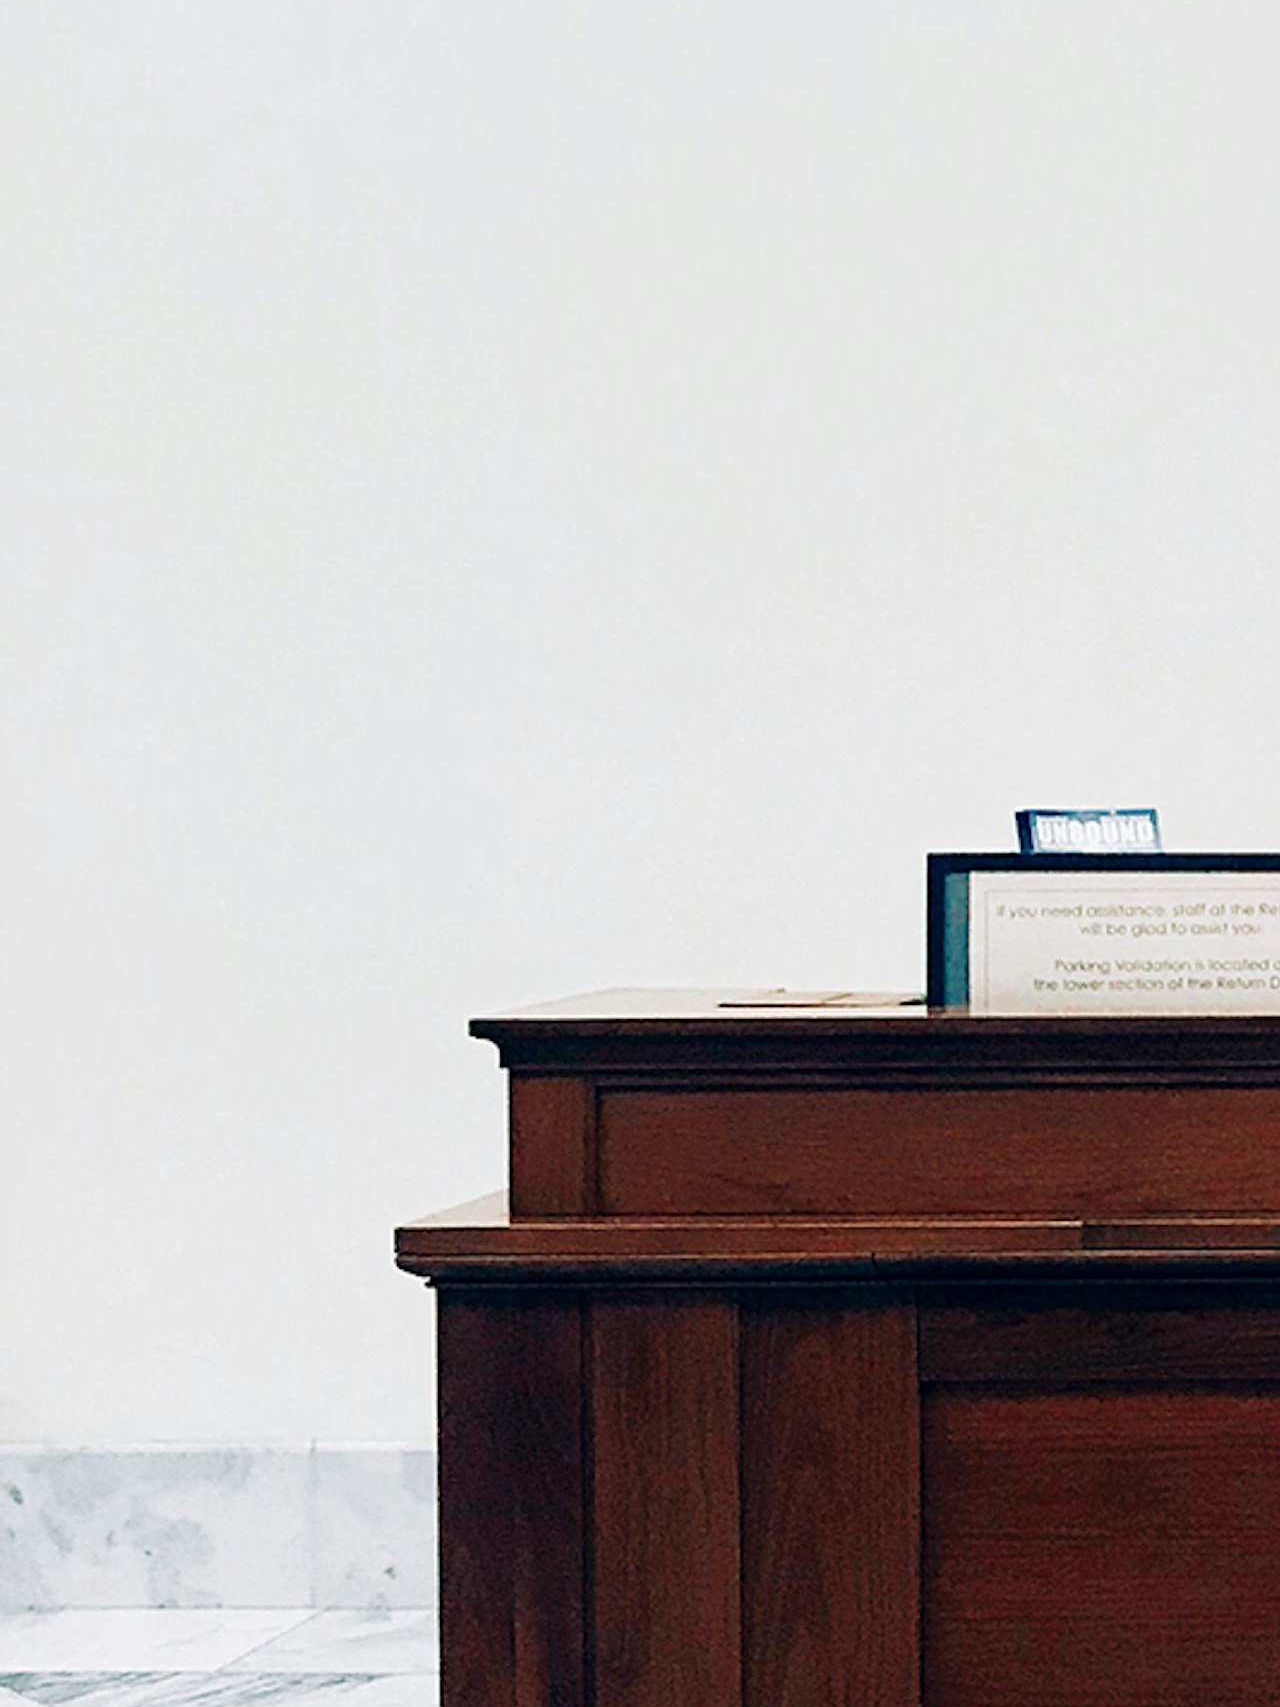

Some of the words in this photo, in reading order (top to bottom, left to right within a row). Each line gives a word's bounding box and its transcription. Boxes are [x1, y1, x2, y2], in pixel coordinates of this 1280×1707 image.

[1036, 816, 1155, 846] UNBOUND
[1009, 908, 1037, 919] you
[1041, 905, 1083, 917] need
[1172, 903, 1206, 916] staff
[1209, 904, 1226, 916] at
[1230, 903, 1255, 915] the
[1080, 923, 1101, 935] will
[1106, 923, 1127, 935] be
[1131, 923, 1167, 938] glad
[1171, 923, 1187, 935] to
[1190, 922, 1228, 935] assist
[1054, 959, 1111, 975] Parking
[1115, 959, 1191, 972] Validation
[1195, 960, 1205, 971] is
[1209, 958, 1270, 971] located
[1033, 978, 1058, 991] the
[1062, 978, 1105, 991] lower
[1108, 978, 1165, 991] section
[1167, 977, 1184, 990] of
[1187, 977, 1213, 990] the
[1217, 977, 1266, 990] Return
